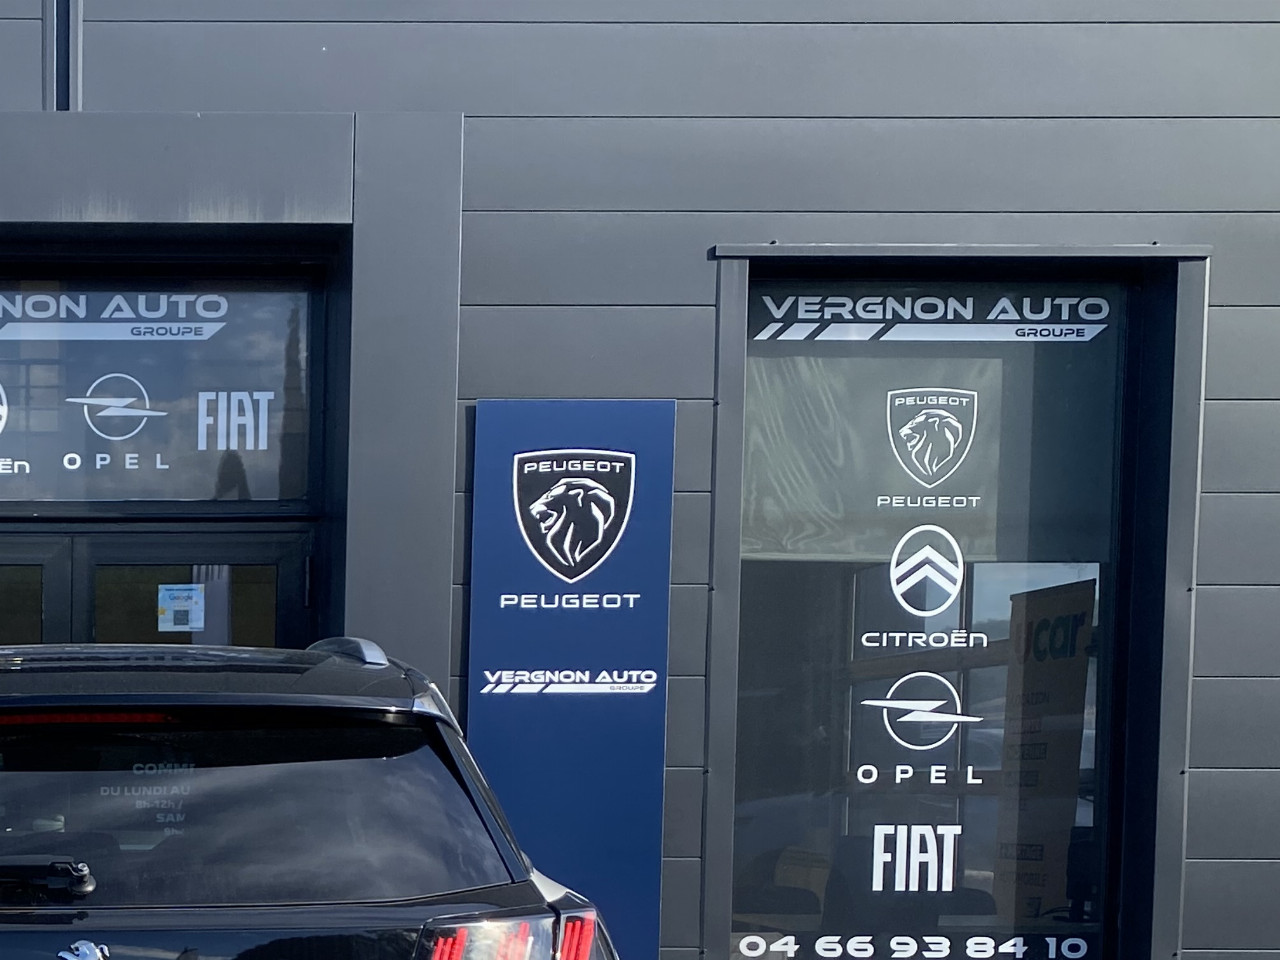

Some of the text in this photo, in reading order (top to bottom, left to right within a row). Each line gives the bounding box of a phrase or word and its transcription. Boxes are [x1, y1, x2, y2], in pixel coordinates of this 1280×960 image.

[100, 294, 229, 319] AUTO
[762, 296, 1110, 321] VERGNON AUTO
[130, 326, 204, 338] GROUPE
[1014, 327, 1086, 338] GROUPE
[894, 396, 970, 406] PEUGEOT
[197, 391, 275, 451] FIAT
[63, 453, 170, 470] OPEL
[524, 461, 625, 474] PEUGEOT
[877, 496, 981, 507] PEUGEOT
[500, 594, 641, 608] PEUGEOT
[483, 670, 657, 683] VERGNON AUTO
[857, 765, 983, 784] OPEL
[872, 825, 962, 892] FIAT
[739, 935, 1088, 959] 04 66 93 84 10
